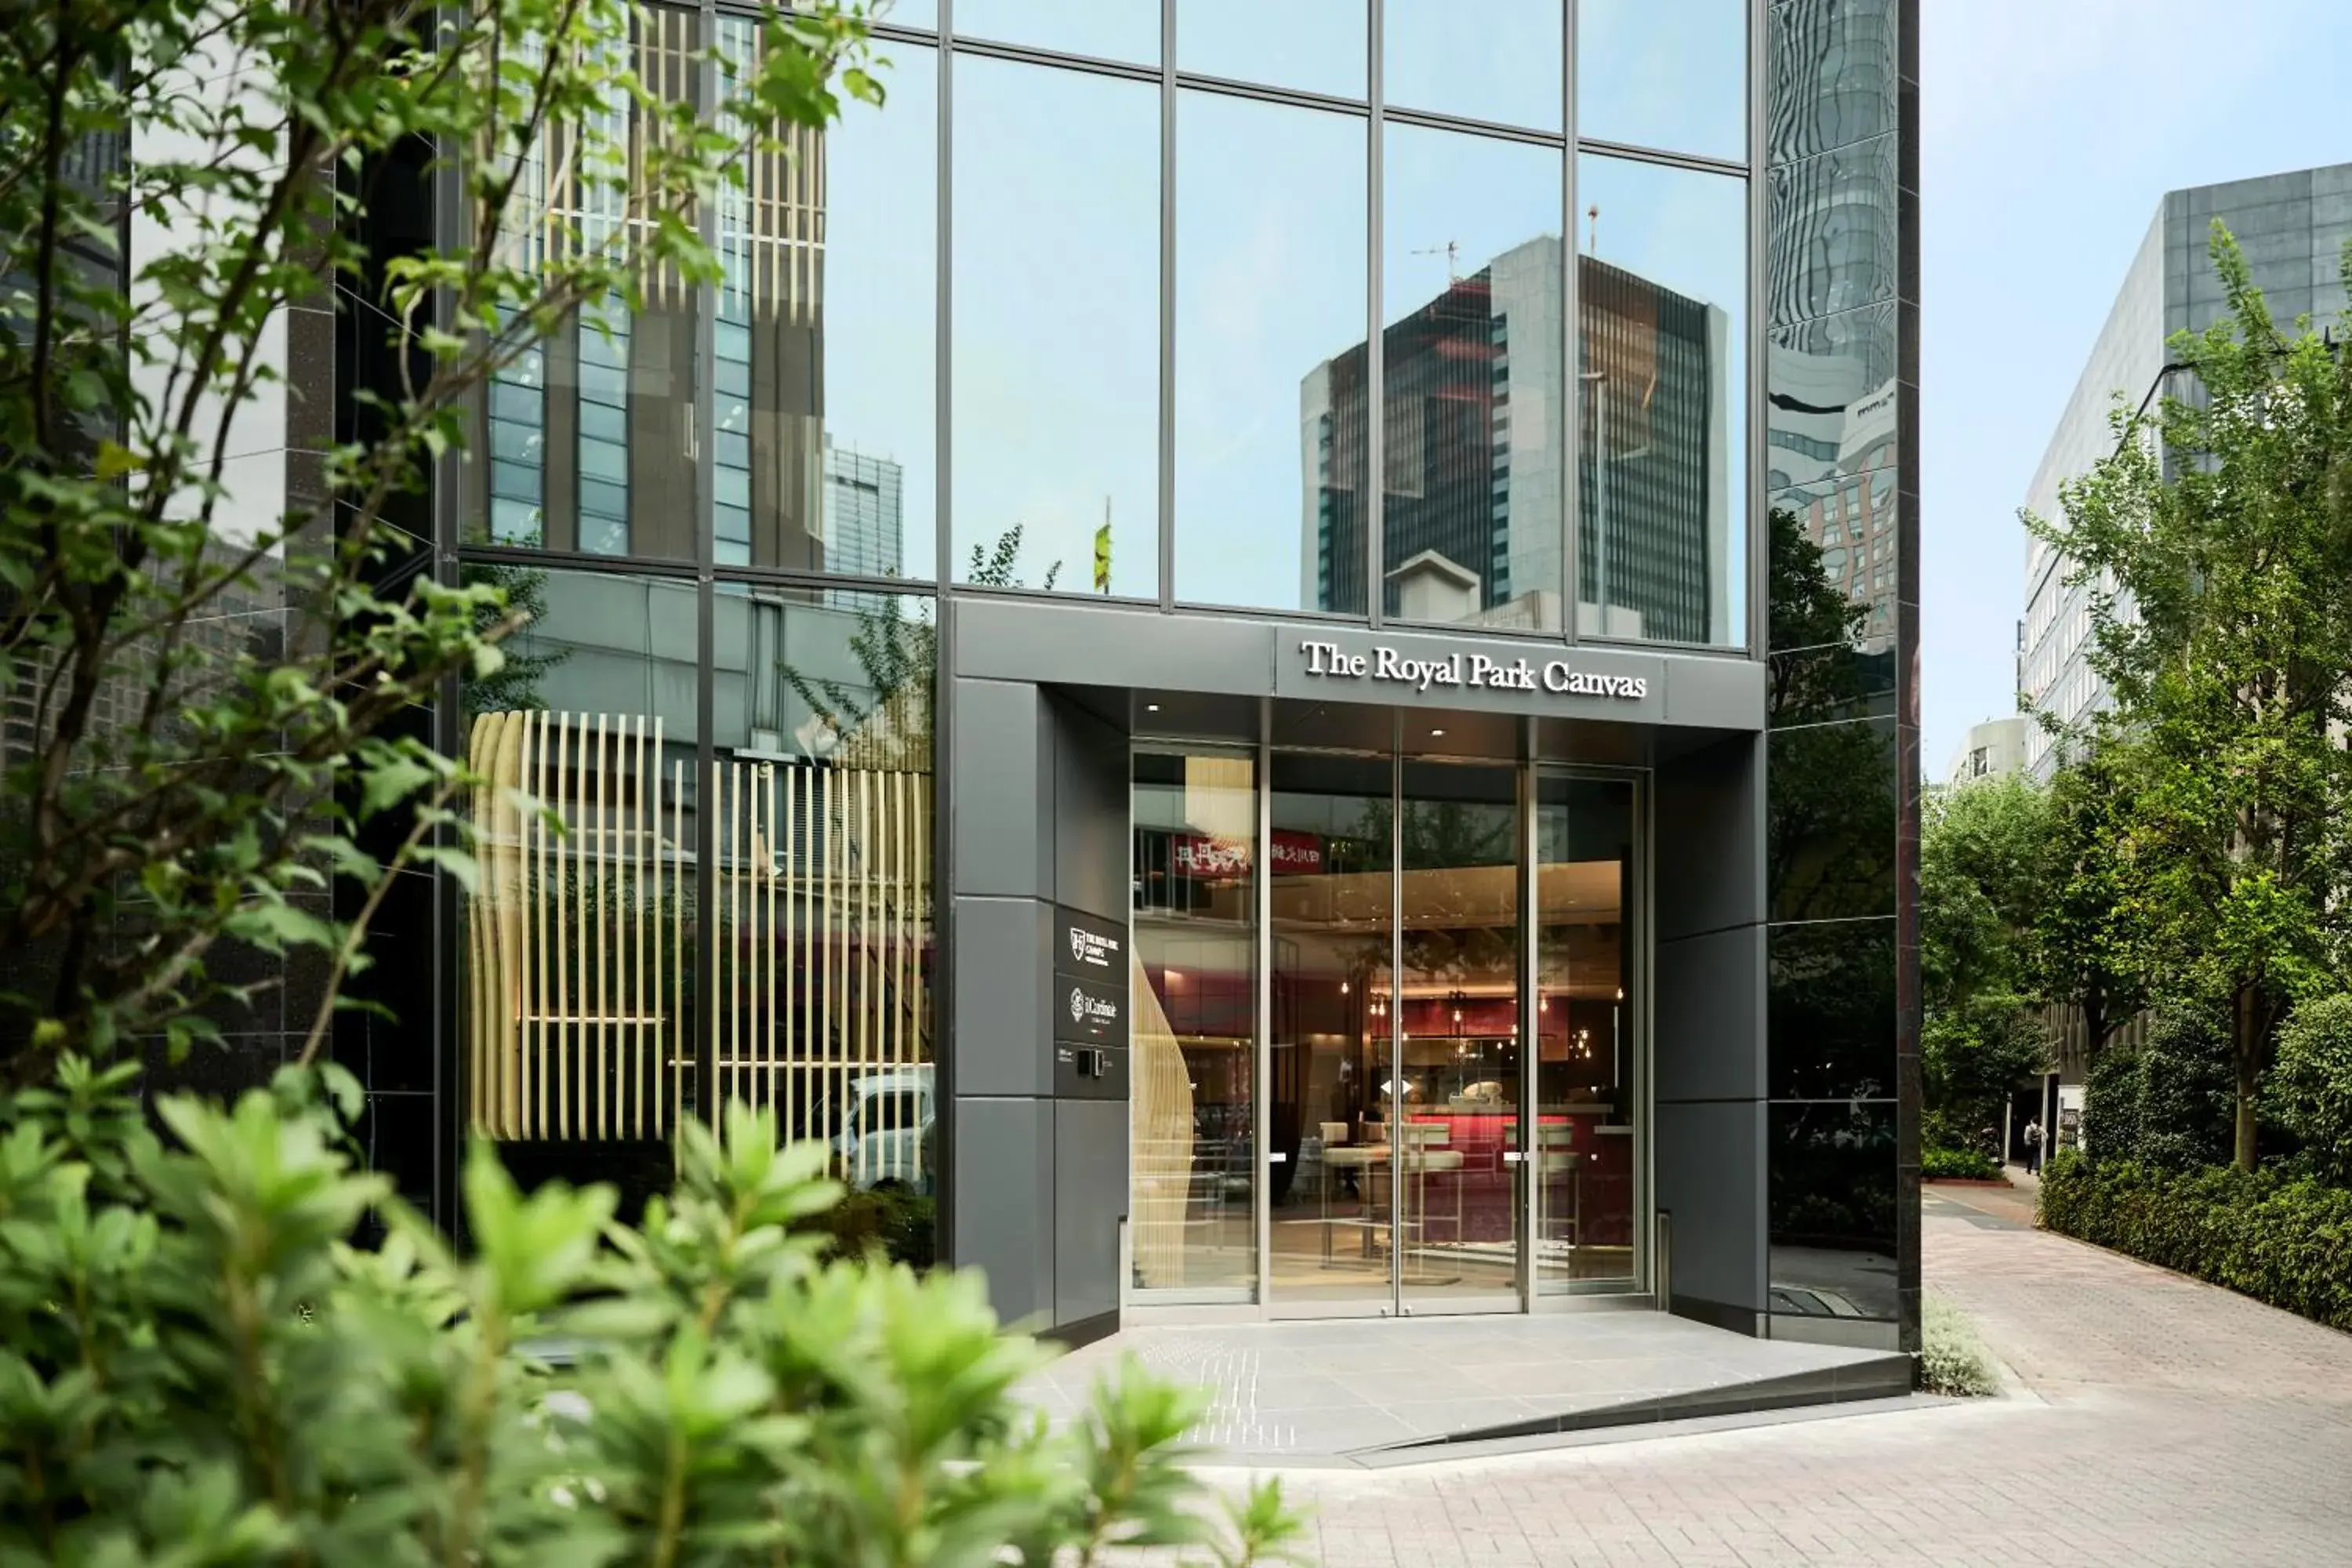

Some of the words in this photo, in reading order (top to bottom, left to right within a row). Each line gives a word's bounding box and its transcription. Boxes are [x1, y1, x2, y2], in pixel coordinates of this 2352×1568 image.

[1301, 641, 1366, 677] The
[1374, 646, 1461, 691] Royal
[1468, 654, 1537, 690] Park
[1544, 660, 1647, 699] Canvas
